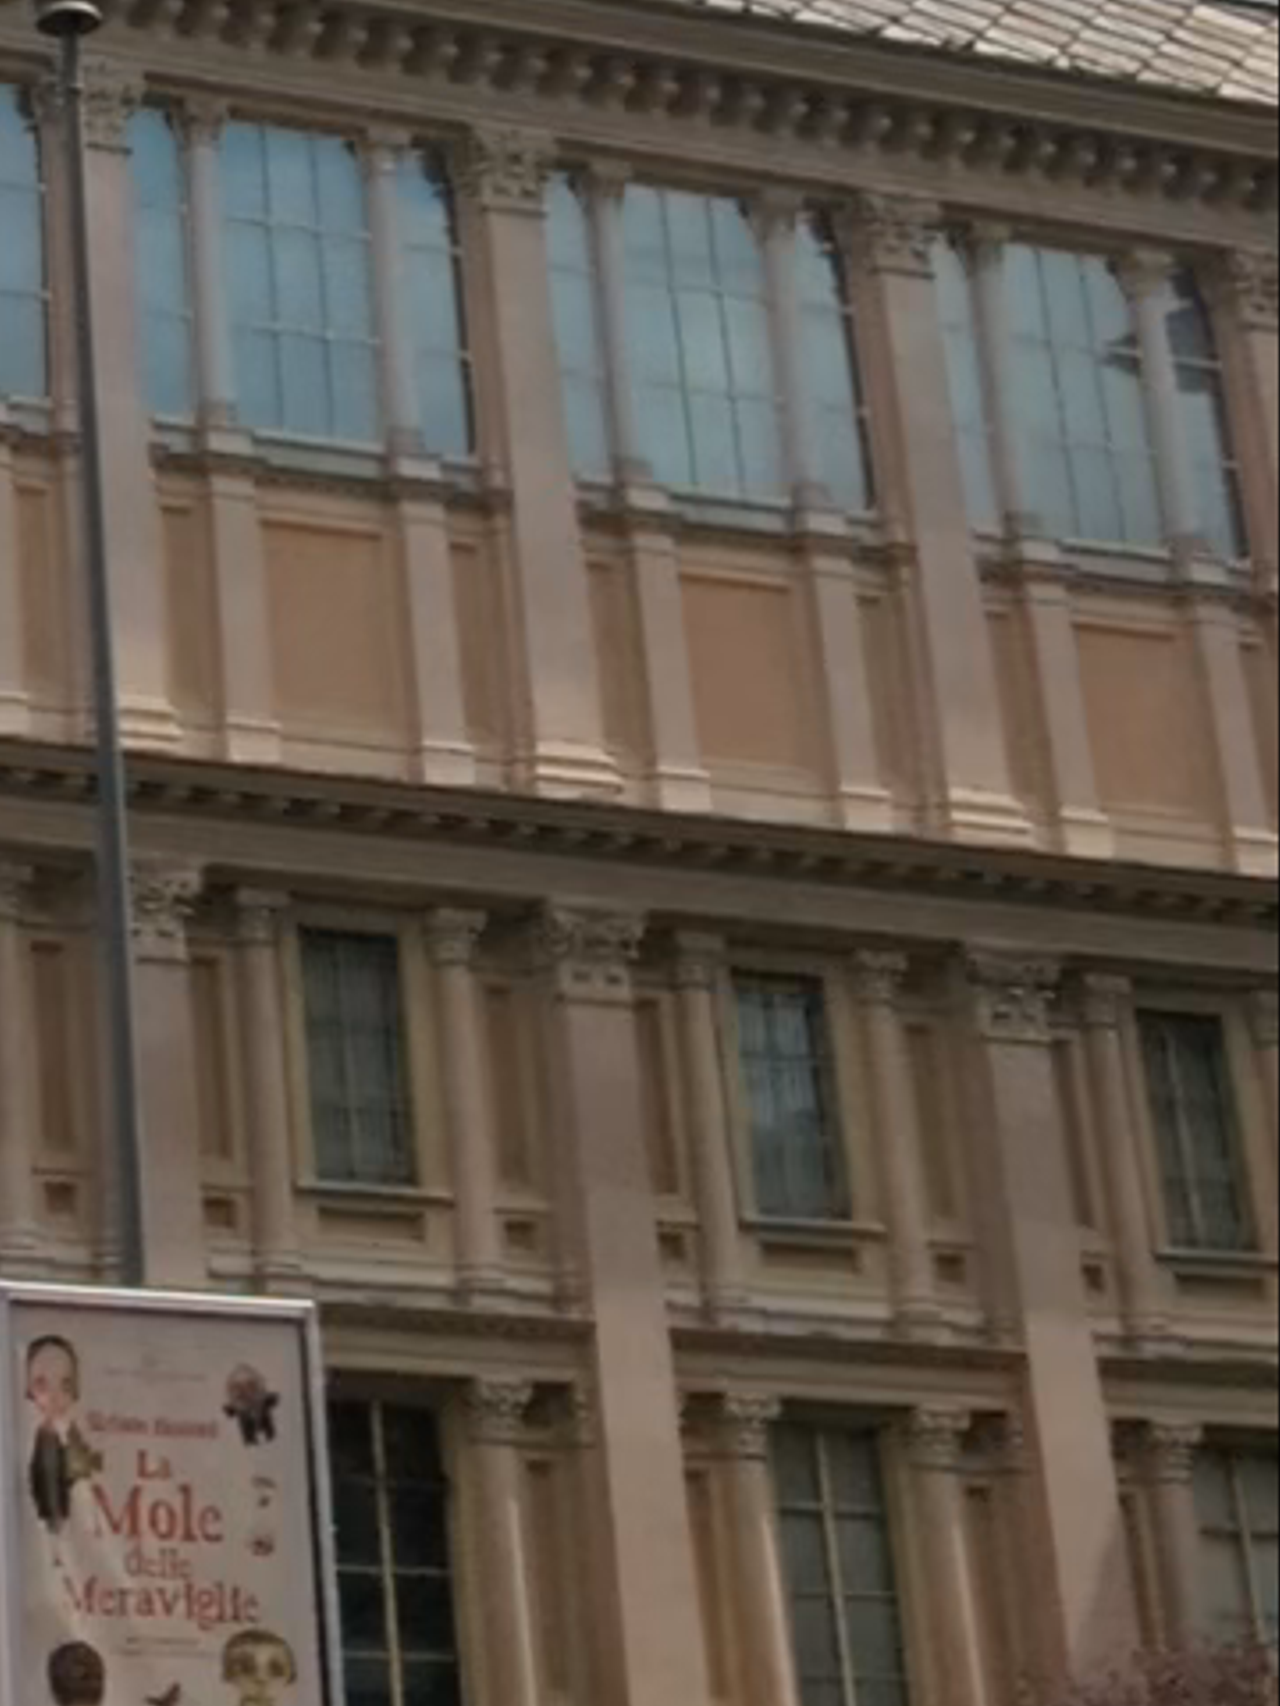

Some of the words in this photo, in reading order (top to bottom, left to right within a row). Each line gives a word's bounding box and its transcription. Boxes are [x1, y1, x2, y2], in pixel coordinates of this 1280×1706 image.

[137, 1449, 172, 1479] La
[92, 1484, 224, 1543] Mole
[125, 1543, 192, 1578] delle
[63, 1576, 261, 1631] Meraviglie
